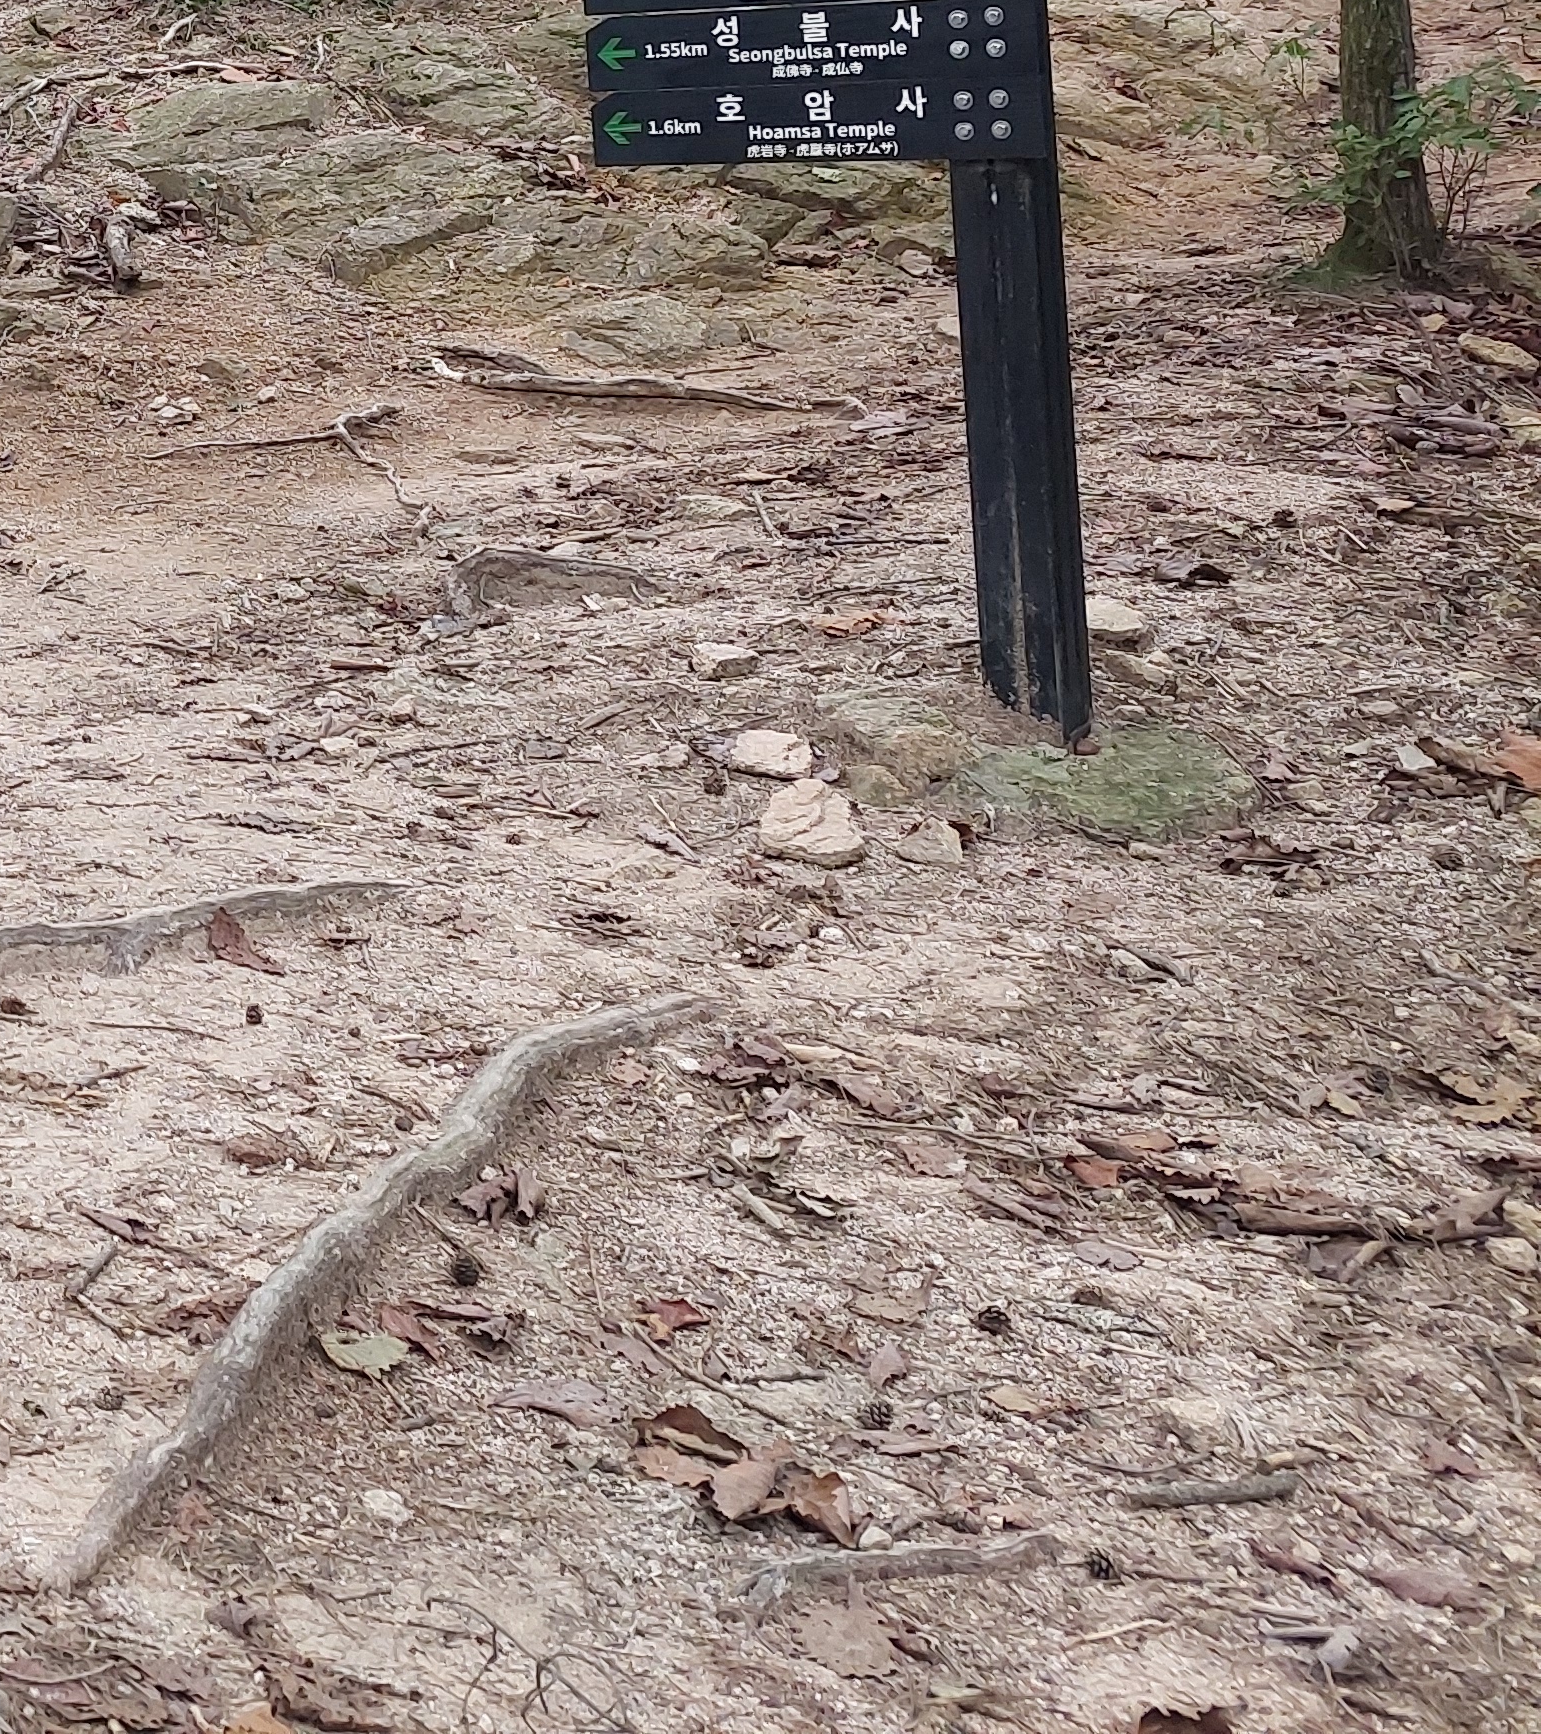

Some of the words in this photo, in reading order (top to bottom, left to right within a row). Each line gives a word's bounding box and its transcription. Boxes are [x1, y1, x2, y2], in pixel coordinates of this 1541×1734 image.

[644, 42, 708, 59] 1.55km
[727, 44, 833, 64] Seongbulsa
[836, 39, 908, 59] Temple
[647, 119, 701, 136] 1.6km
[748, 124, 822, 141] Hoamsa
[825, 120, 896, 140] Temple
